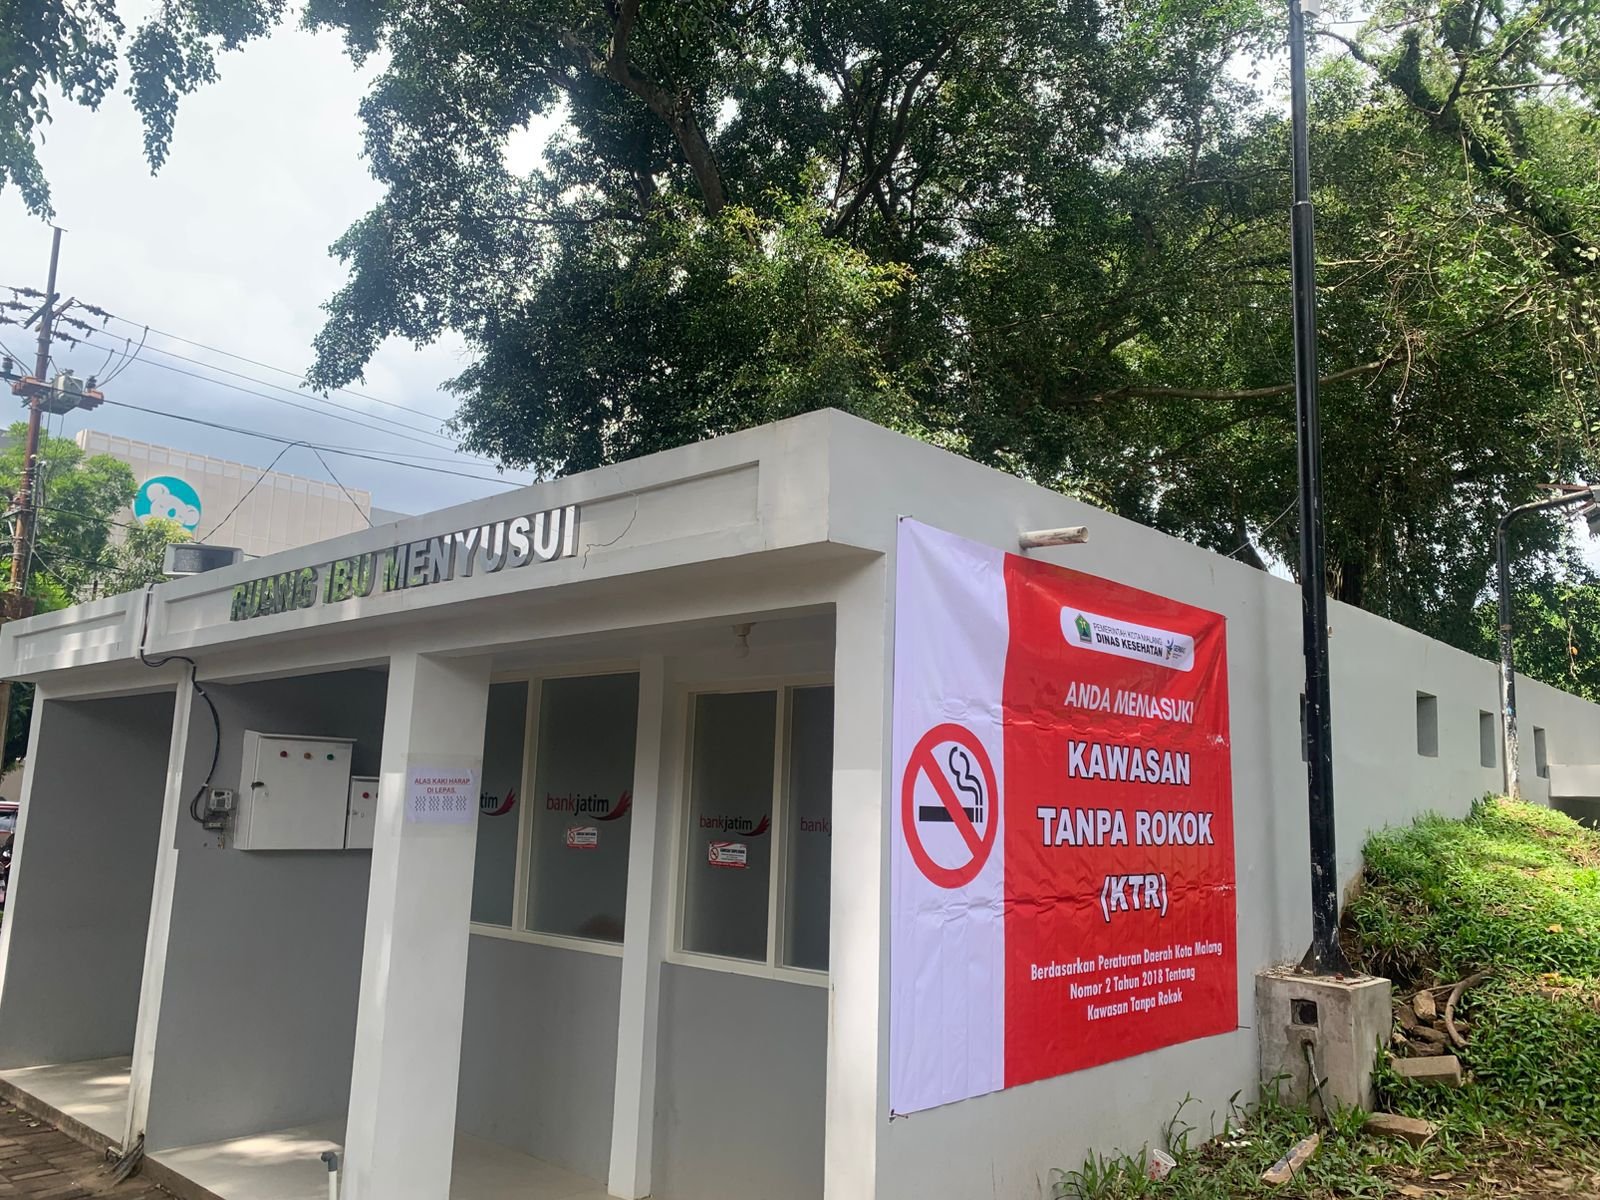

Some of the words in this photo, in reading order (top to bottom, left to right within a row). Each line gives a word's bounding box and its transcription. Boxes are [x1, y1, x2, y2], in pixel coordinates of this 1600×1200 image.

[230, 567, 318, 621] RUANG
[323, 552, 378, 604] IBU
[382, 505, 581, 592] MENYUSUI
[1095, 632, 1121, 648] DINAS
[1121, 638, 1163, 657] KESEHATAN
[1064, 681, 1110, 713] ANDA
[1113, 689, 1194, 724] MEMASUKI
[1067, 740, 1191, 786] KAWASAN
[427, 786, 434, 794] DI
[546, 792, 609, 816] bankjatim
[700, 815, 753, 832] bankjatim
[1036, 806, 1128, 847] TANPA
[1135, 810, 1215, 846] ROKOK
[1100, 873, 1168, 923] (KTR)
[1030, 957, 1095, 981] Berdasarkan
[1098, 952, 1142, 970] Peraturan
[1143, 945, 1173, 963] Daerah
[1175, 943, 1193, 960] Kota
[1194, 940, 1222, 957] Malang
[1070, 982, 1103, 1000] Nomor
[1105, 978, 1112, 993] 2
[1114, 974, 1140, 992] Tahun
[1142, 969, 1164, 987] 2018
[1165, 967, 1196, 983] Tentang
[1087, 1003, 1129, 1021] Kawasan
[1130, 996, 1156, 1014] Tanpa
[1158, 987, 1183, 1006] Rokok
